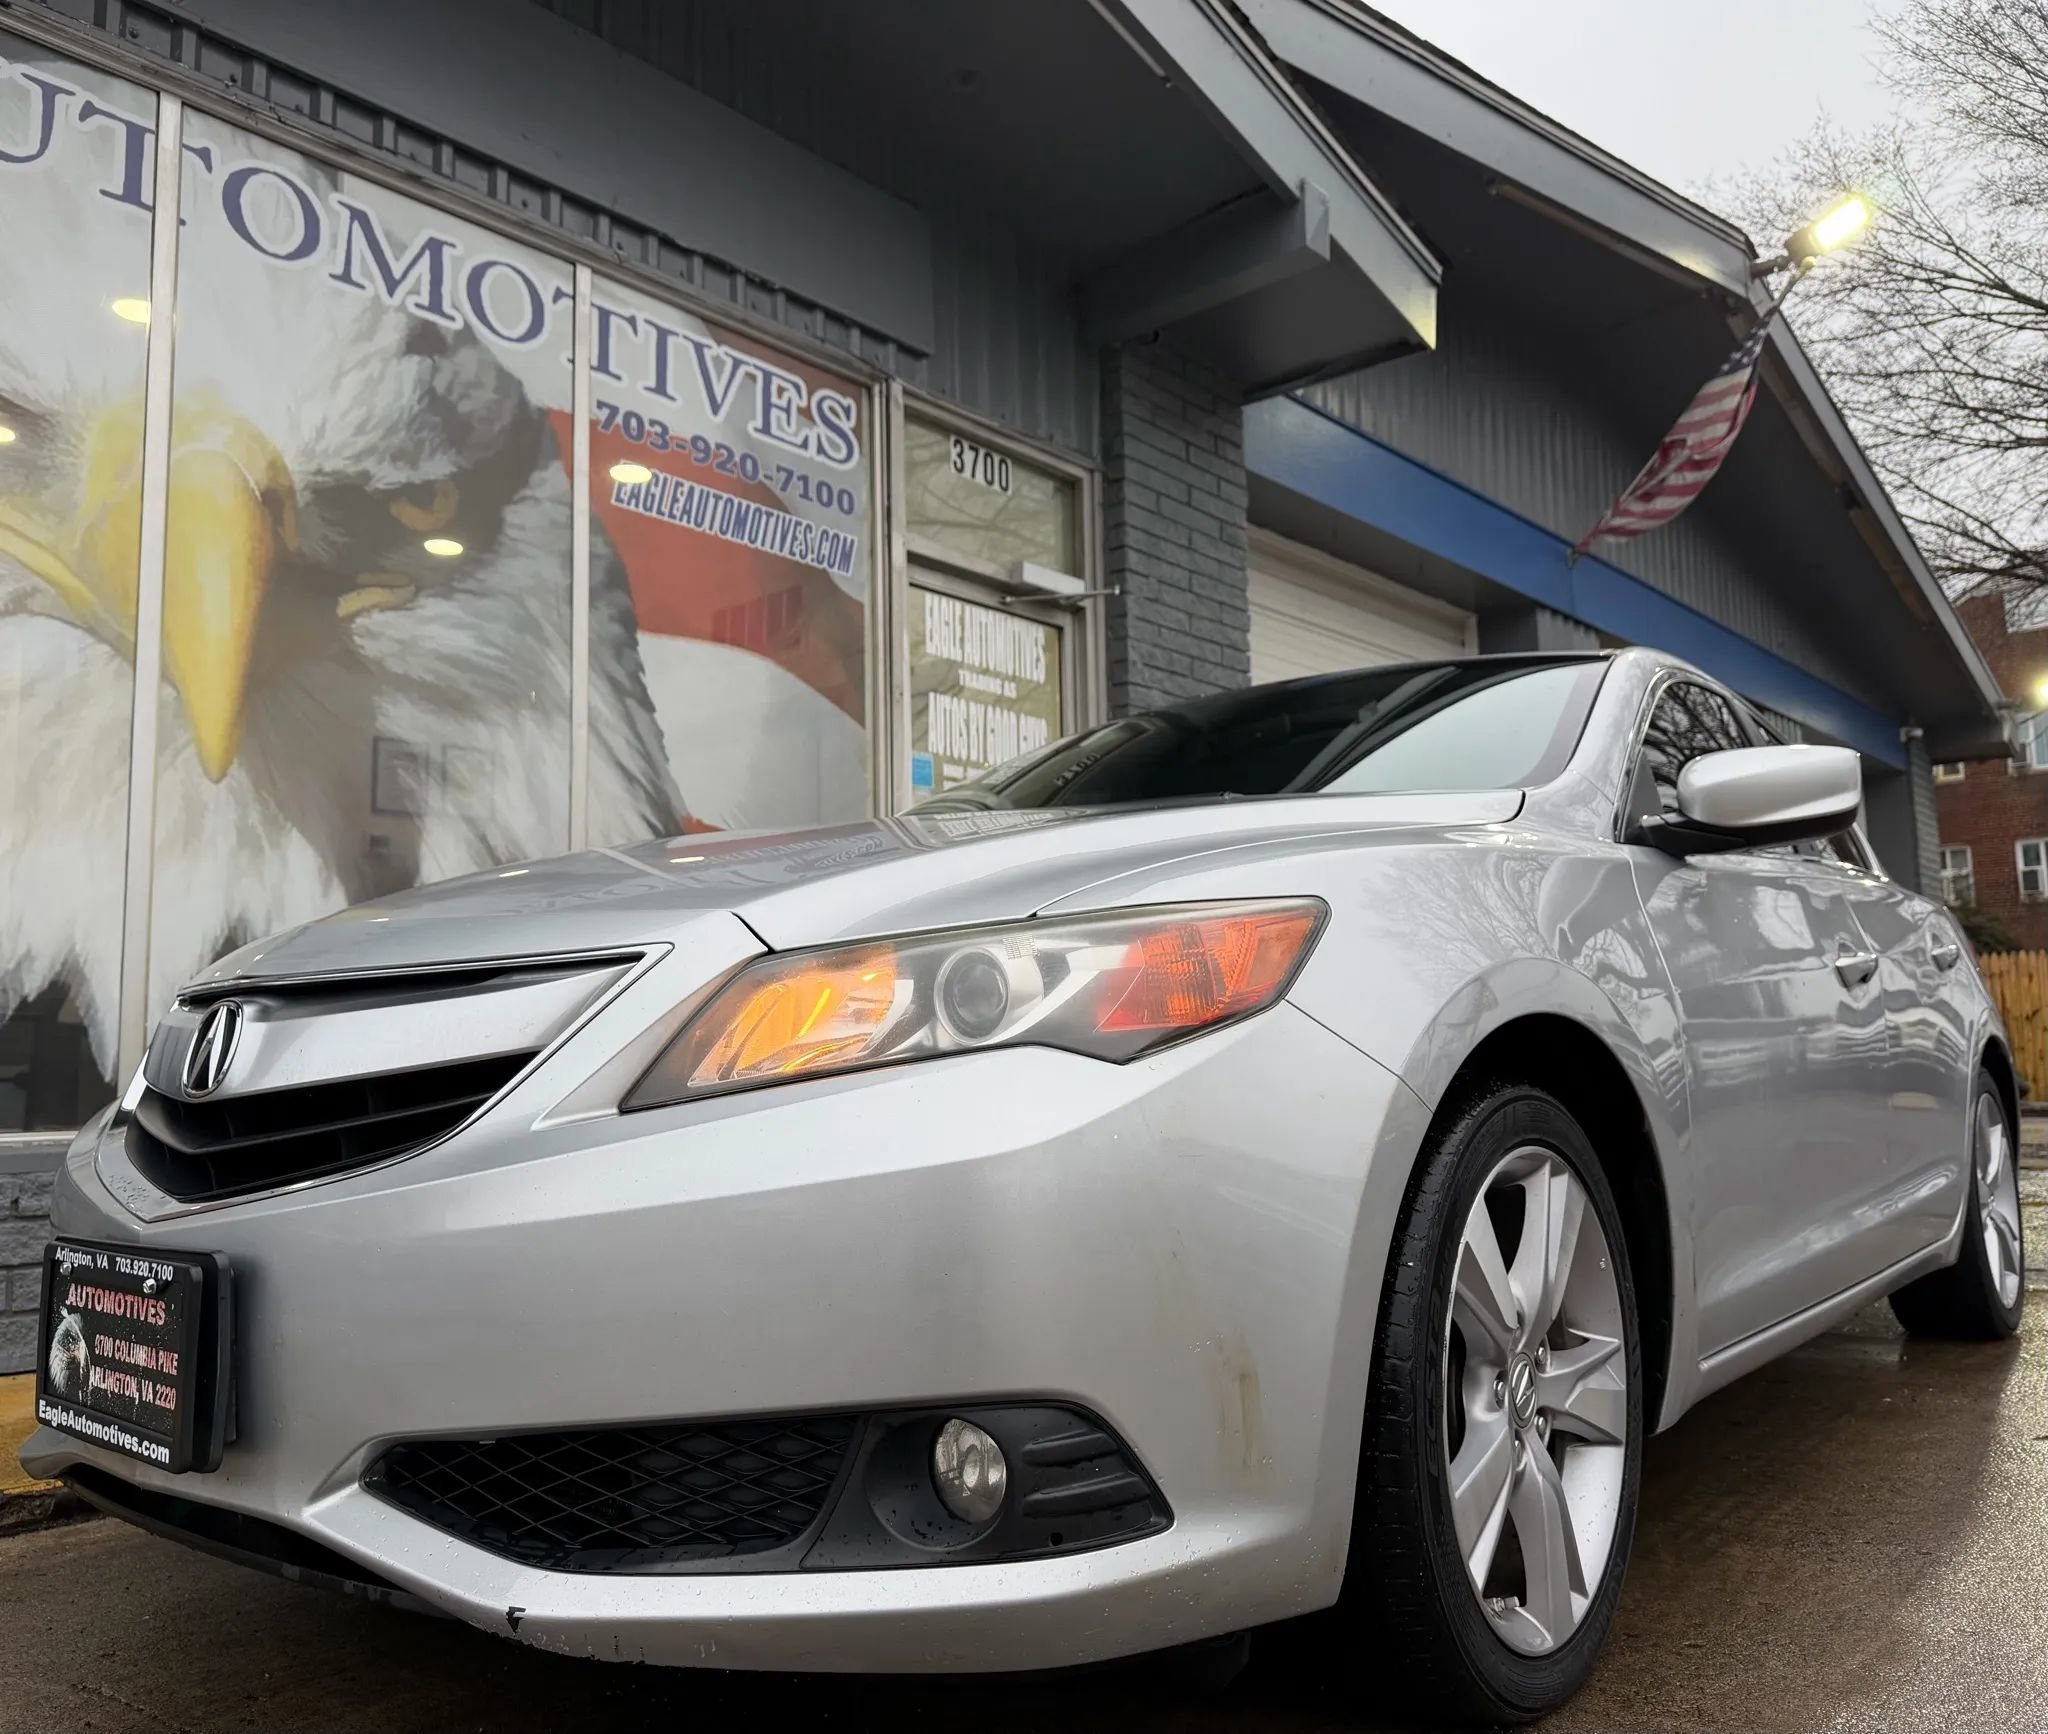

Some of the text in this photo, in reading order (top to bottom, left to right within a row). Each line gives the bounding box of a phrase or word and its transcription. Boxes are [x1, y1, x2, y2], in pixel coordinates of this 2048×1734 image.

[595, 400, 855, 515] 703-920-7100
[953, 440, 1011, 493] 3700
[924, 591, 1046, 684] EAGLE AUTOMOTIVES
[928, 691, 969, 761] AUTOS
[969, 701, 985, 764] BY
[55, 1246, 174, 1282] Arlington, VA 703.920.7100
[65, 1282, 167, 1326] AUTOMOTIVES
[114, 1339, 157, 1370] COLUMBIA
[158, 1349, 179, 1376] PIKE
[89, 1365, 140, 1405] ARLINGTON,
[141, 1379, 154, 1404] VA
[39, 1399, 171, 1464] EagleAutomotives.com
